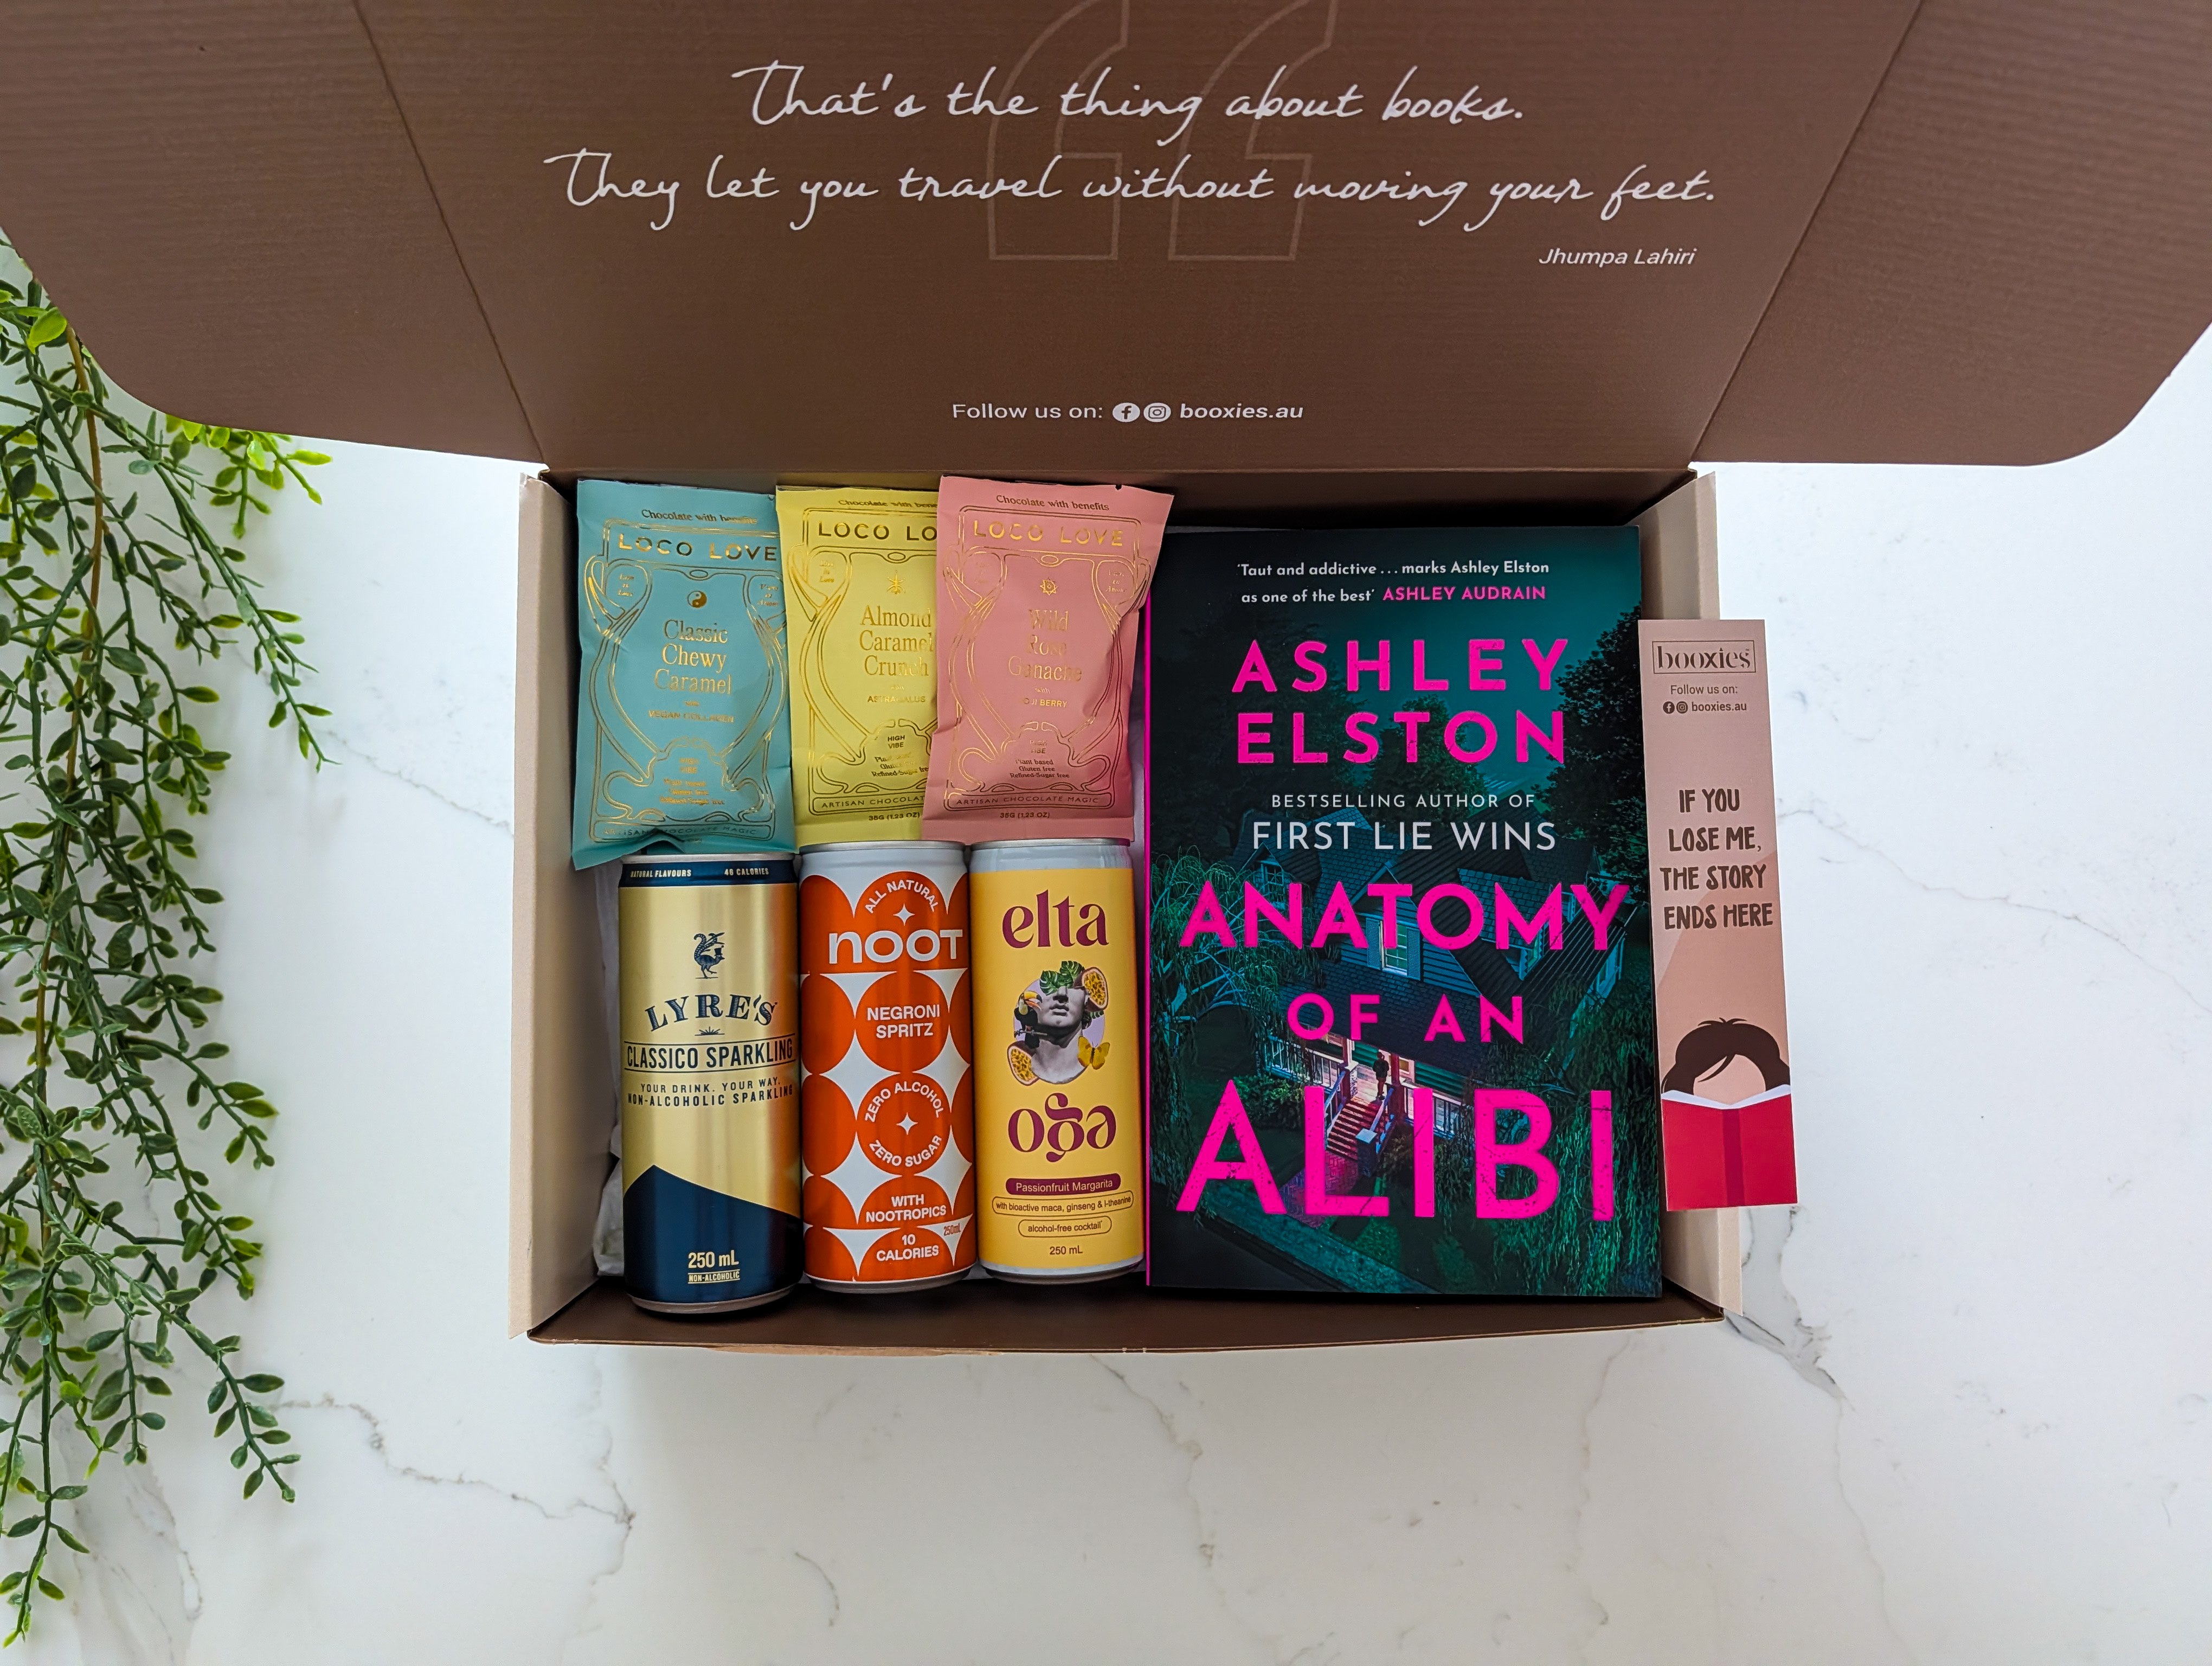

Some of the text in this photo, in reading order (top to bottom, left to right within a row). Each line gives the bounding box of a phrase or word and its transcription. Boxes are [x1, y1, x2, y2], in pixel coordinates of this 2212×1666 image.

[731, 60, 1523, 145] That's the thing about books.
[543, 148, 1715, 232] They let you travel without moving your feet.
[1538, 248, 1695, 268] Jhumpa Lahiri
[953, 403, 1303, 419] Follow us on: booxies.au
[996, 495, 1110, 511] Chocolate with benefits
[641, 509, 692, 521] Chocolate
[696, 513, 717, 522] with
[819, 521, 937, 541] LOCO LO
[973, 520, 1123, 546] LOCO LOVE
[619, 533, 777, 561] LOCO LOVE
[1277, 563, 1304, 575] and
[1309, 562, 1377, 575] addictive
[1402, 561, 1446, 574] marks
[1451, 561, 1499, 576] Ashley
[1504, 561, 1549, 574] Elston
[1242, 592, 1257, 603] as
[1262, 592, 1288, 603] one
[1292, 589, 1310, 603] of
[1313, 589, 1335, 602] the
[1382, 587, 1456, 601] ASHLEY
[1462, 586, 1546, 600] AUDRAIN
[860, 605, 931, 627] Almond
[1029, 610, 1069, 630] Wild
[664, 619, 728, 644] Classic
[859, 630, 933, 652] Caramel
[661, 643, 727, 672] Chewy
[864, 655, 928, 676] Crunch
[1008, 655, 1082, 681] Ganache
[1232, 638, 1568, 693] ASHLEY
[1657, 646, 1751, 669] booxies
[654, 668, 732, 694] Caramel
[1670, 684, 1704, 694] Follow
[1040, 699, 1067, 707] BERRY
[1692, 701, 1747, 712] booxies.au
[1238, 710, 1564, 764] ELSTON
[870, 796, 924, 805] CHOCOLAT
[1271, 793, 1534, 808] BESTSELLING AUTHOR OF
[1679, 789, 1740, 812] IF YOU
[723, 826, 756, 835] MAGIC
[1253, 822, 1556, 850] FIRST LIE WINS
[1669, 826, 1761, 851] LOSE ME,
[654, 869, 692, 877] FLAVOURS
[1660, 864, 1766, 890] THE STORY
[865, 879, 938, 914] ALL NATURAL
[1002, 889, 1109, 949] elta
[1179, 880, 1630, 950] ANATOMY
[1664, 902, 1773, 930] ENDS HERE
[645, 994, 776, 1031] LYRE'S
[867, 1004, 941, 1021] NEGRONI
[1287, 993, 1523, 1044] OF AN
[876, 1023, 934, 1039] SPRITZ
[627, 1038, 793, 1069] CLASSICO SPARKLING
[628, 1084, 793, 1107] NON-ALCOHOLIC SPARKLING
[641, 1077, 781, 1093] YOUR DRINK. YOUR WAY.
[865, 1081, 945, 1123] ZERO ALCOHOL
[869, 1135, 942, 1167] ZERO SUGAR
[1176, 1080, 1614, 1220] ALIBI
[1016, 1179, 1113, 1193] Passionfruit Margarita
[891, 1194, 924, 1207] WITH
[1009, 1203, 1039, 1212] bioactive
[1066, 1202, 1095, 1213] ginseng
[866, 1205, 946, 1222] NOOTROPICS
[1028, 1224, 1072, 1232] alcohol-free
[902, 1234, 915, 1245] 10
[1050, 1245, 1083, 1255] 250 mL
[688, 1250, 739, 1268] 250 mL
[876, 1246, 939, 1261] CALORIES
[689, 1271, 740, 1282] NON-ALCOHOLIC
